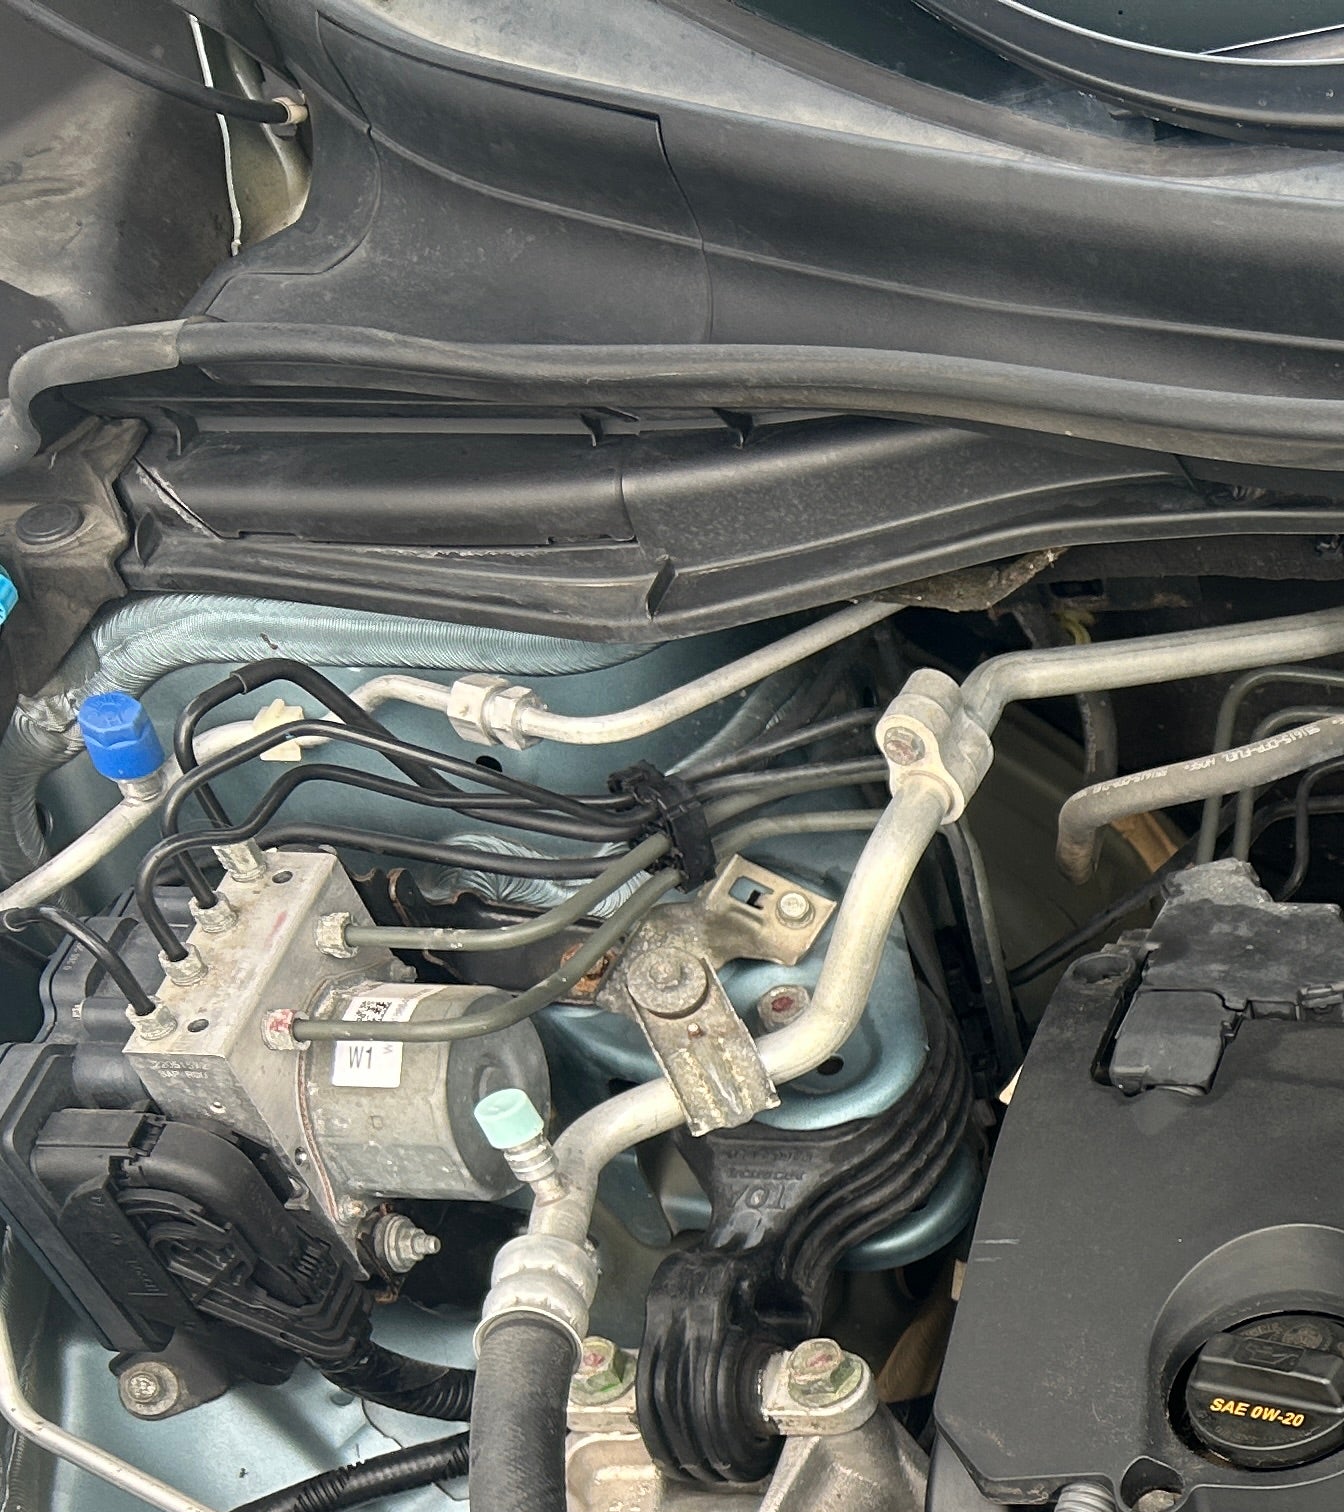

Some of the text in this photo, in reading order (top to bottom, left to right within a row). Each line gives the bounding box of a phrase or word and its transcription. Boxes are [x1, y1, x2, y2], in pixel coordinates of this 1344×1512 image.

[349, 1046, 372, 1068] W1
[1209, 1398, 1304, 1427] SAE 0W-20
